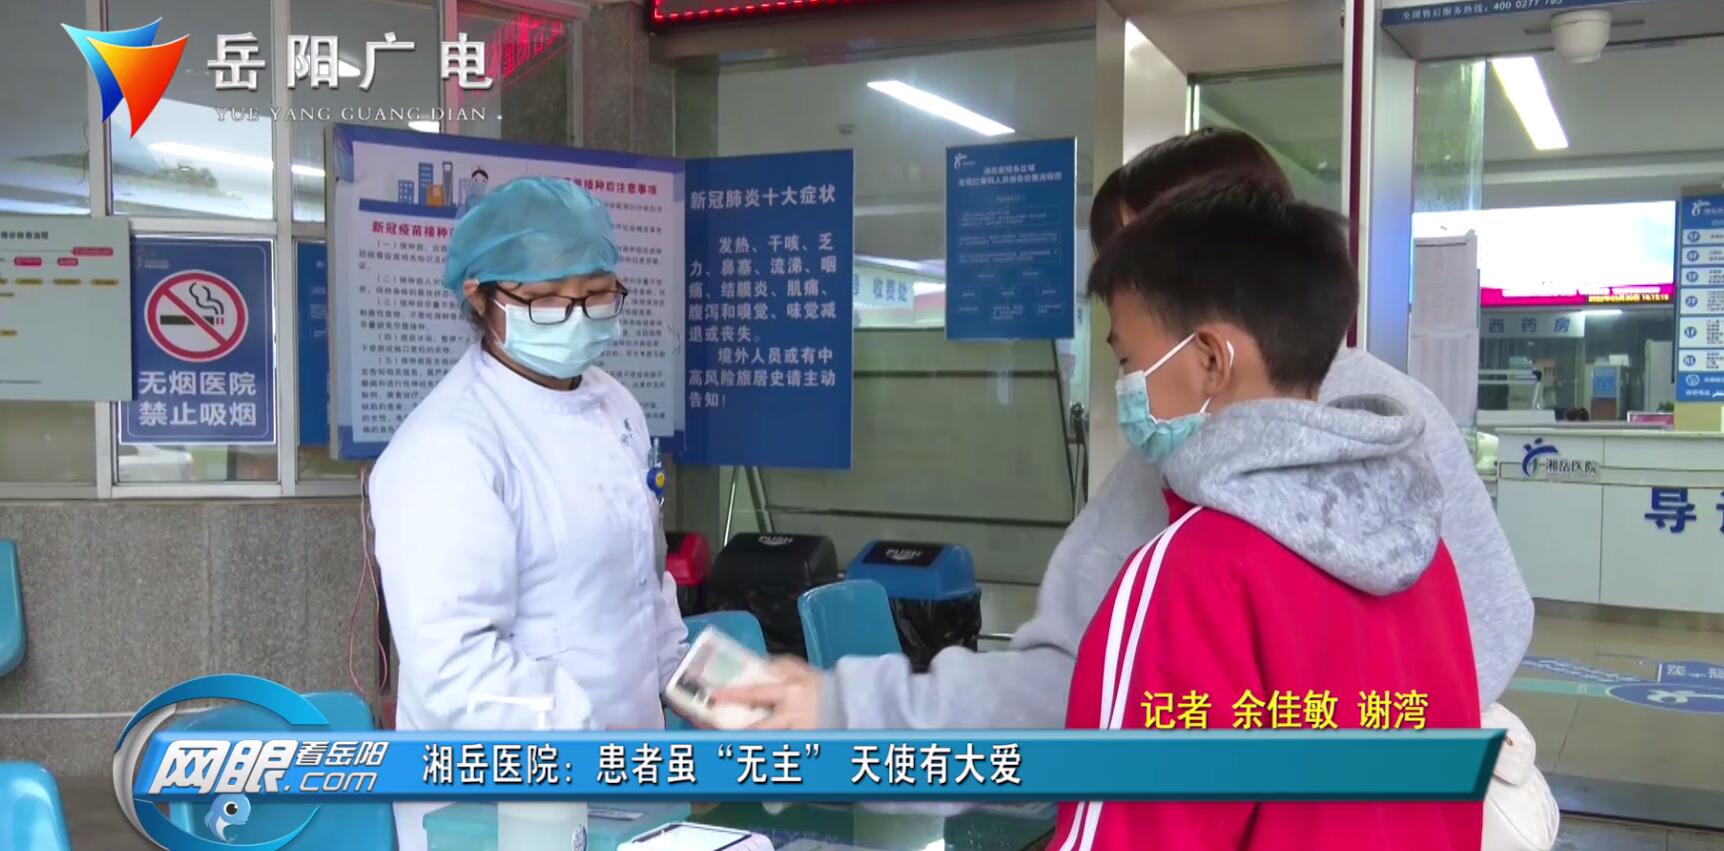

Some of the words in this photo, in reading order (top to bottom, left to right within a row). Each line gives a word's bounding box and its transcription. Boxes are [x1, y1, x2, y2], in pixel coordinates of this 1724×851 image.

[690, 184, 837, 210] 新冠肺炎十大症状
[719, 233, 834, 254] 发热、干咳、乏
[873, 278, 908, 302] 收费处
[689, 302, 837, 322] 腹泻和嗅觉、味觉减
[689, 326, 761, 344] 退或丧失。
[1488, 318, 1570, 333] 西药房
[718, 346, 833, 366] 境外人员或有中
[138, 371, 257, 396] 无烟医院
[689, 369, 836, 388] 高风险旅居史请主动
[139, 401, 257, 427] 禁止吸烟
[1546, 458, 1599, 475] 湘岳医院
[758, 535, 794, 545] PUSH
[885, 548, 922, 559] PUSH
